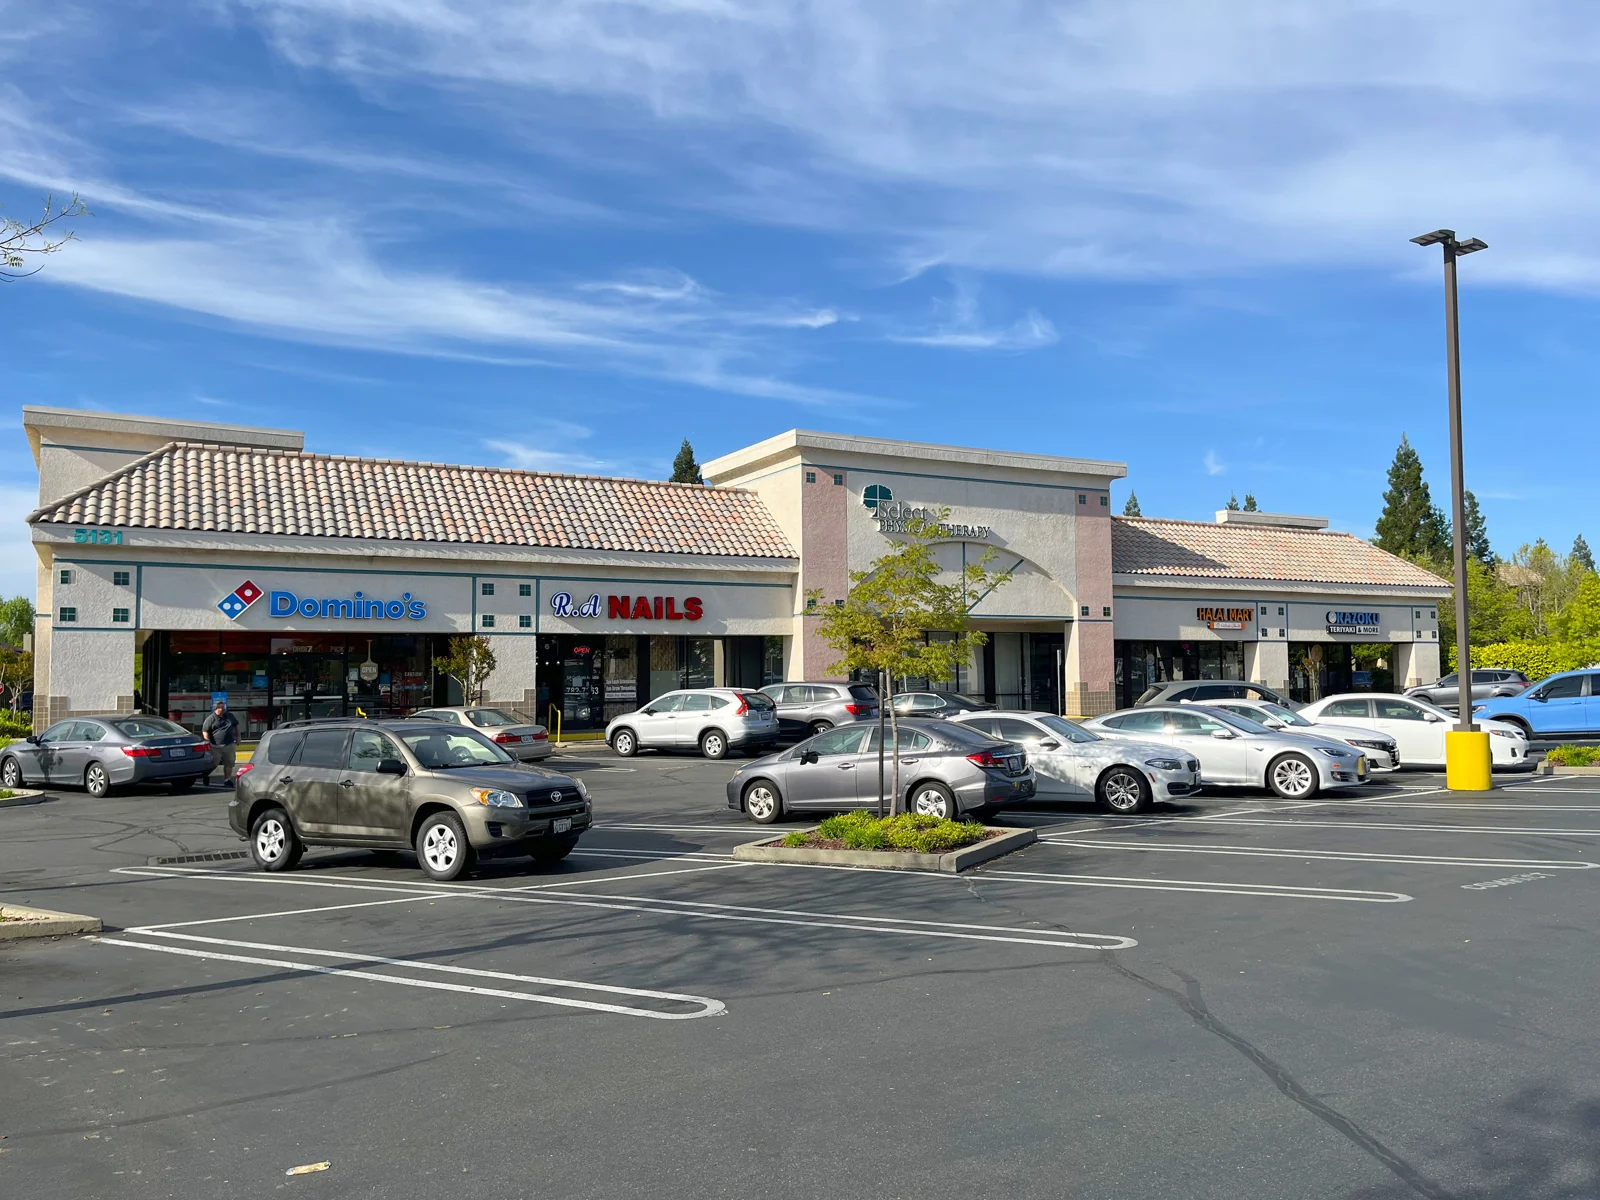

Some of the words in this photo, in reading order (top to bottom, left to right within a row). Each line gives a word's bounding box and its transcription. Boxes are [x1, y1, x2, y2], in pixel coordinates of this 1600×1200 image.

[879, 501, 928, 521] Select
[74, 528, 123, 545] 5131
[939, 523, 991, 538] THERAPY
[269, 590, 427, 620] Domino's
[608, 595, 704, 620] NAILS
[1197, 608, 1228, 621] HALAL
[1229, 608, 1255, 621] MART
